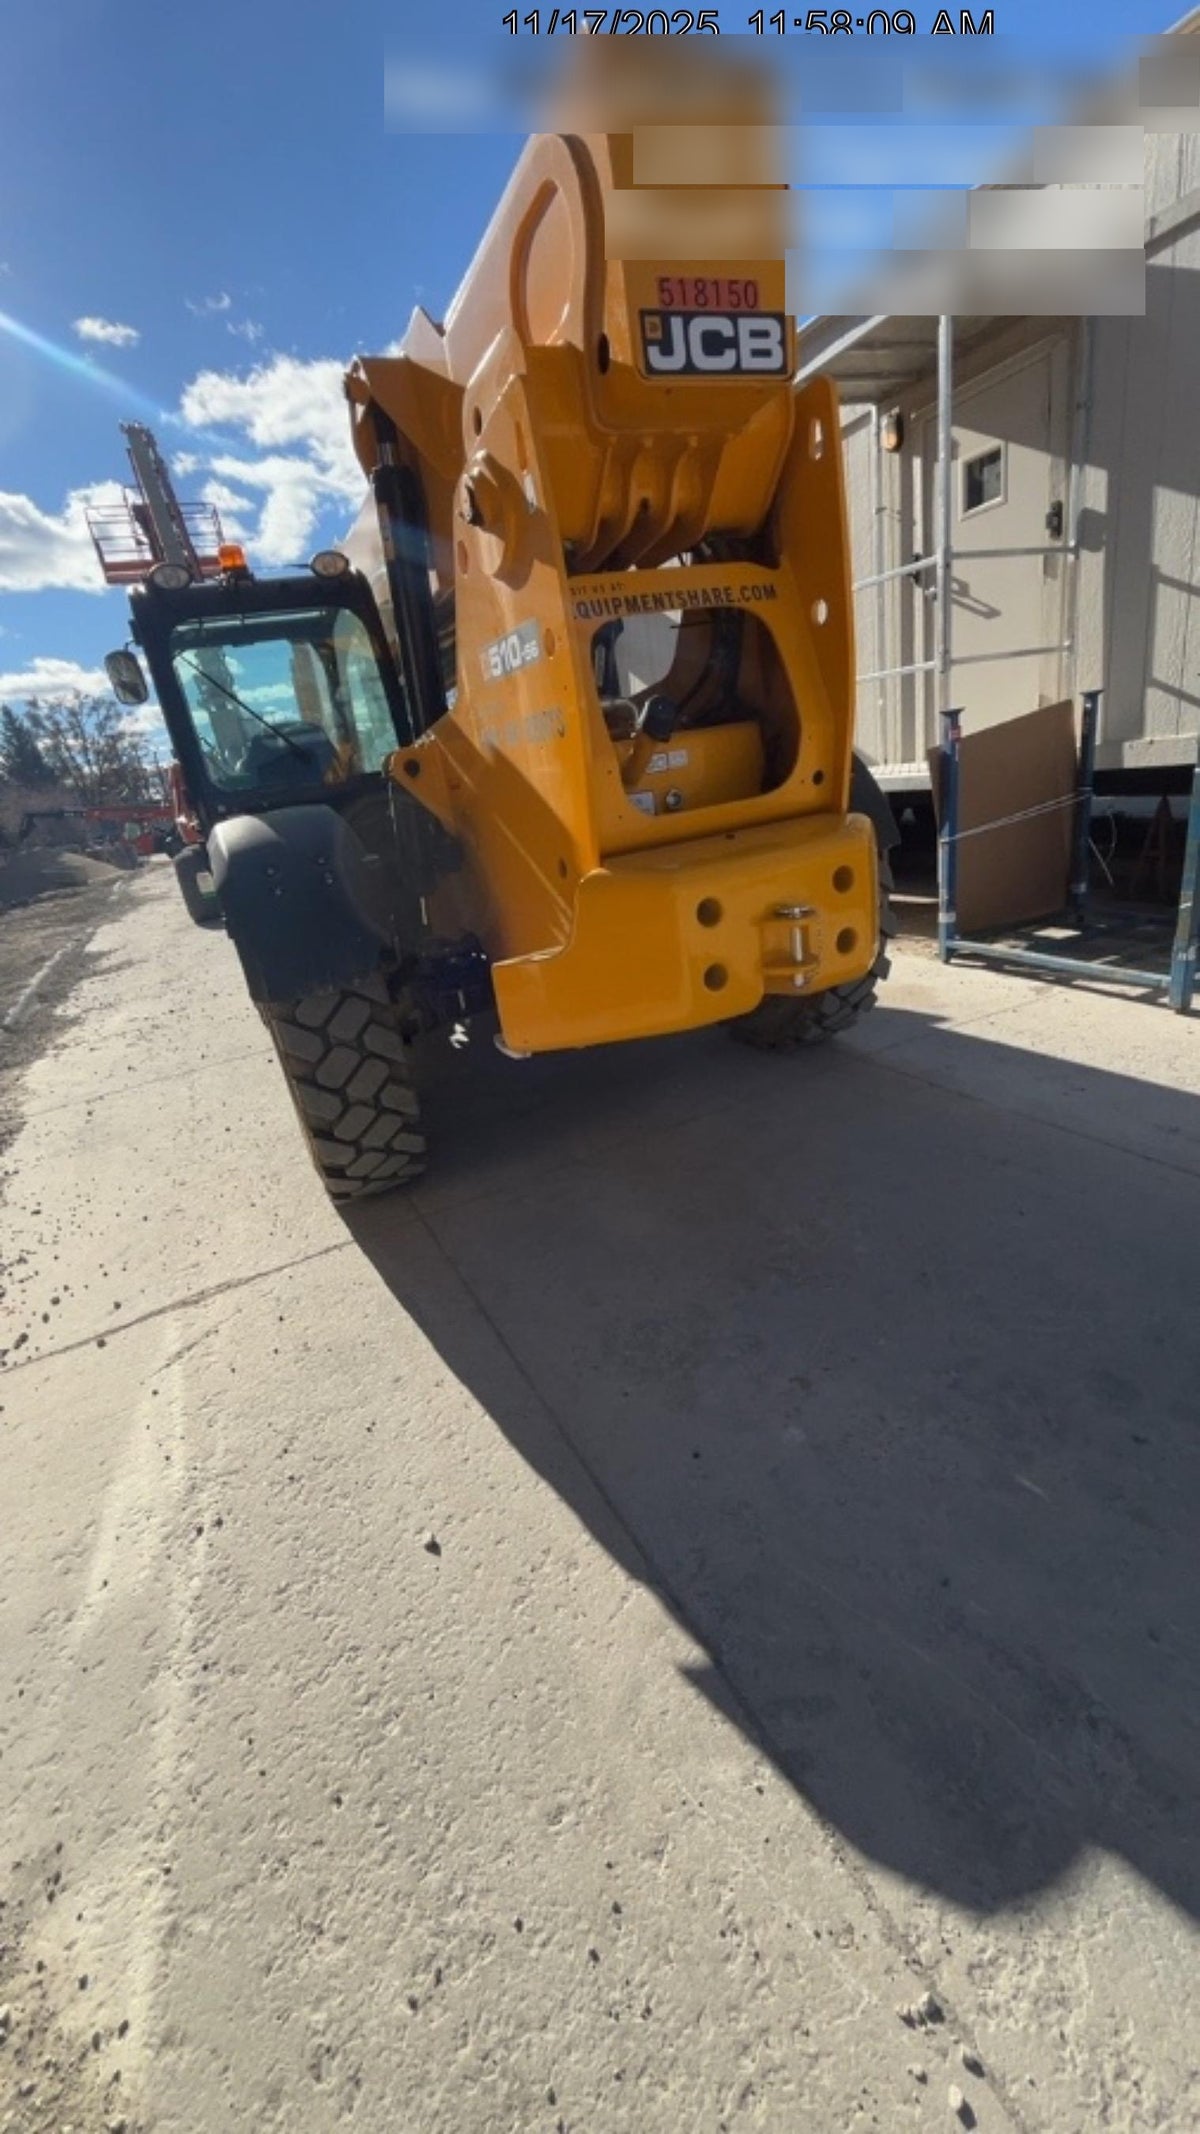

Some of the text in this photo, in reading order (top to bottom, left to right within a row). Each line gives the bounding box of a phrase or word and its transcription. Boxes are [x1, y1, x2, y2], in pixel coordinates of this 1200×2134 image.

[659, 277, 758, 309] 518150
[646, 314, 784, 371] JCB
[573, 584, 777, 619] QUIPMENTSHARE.COM
